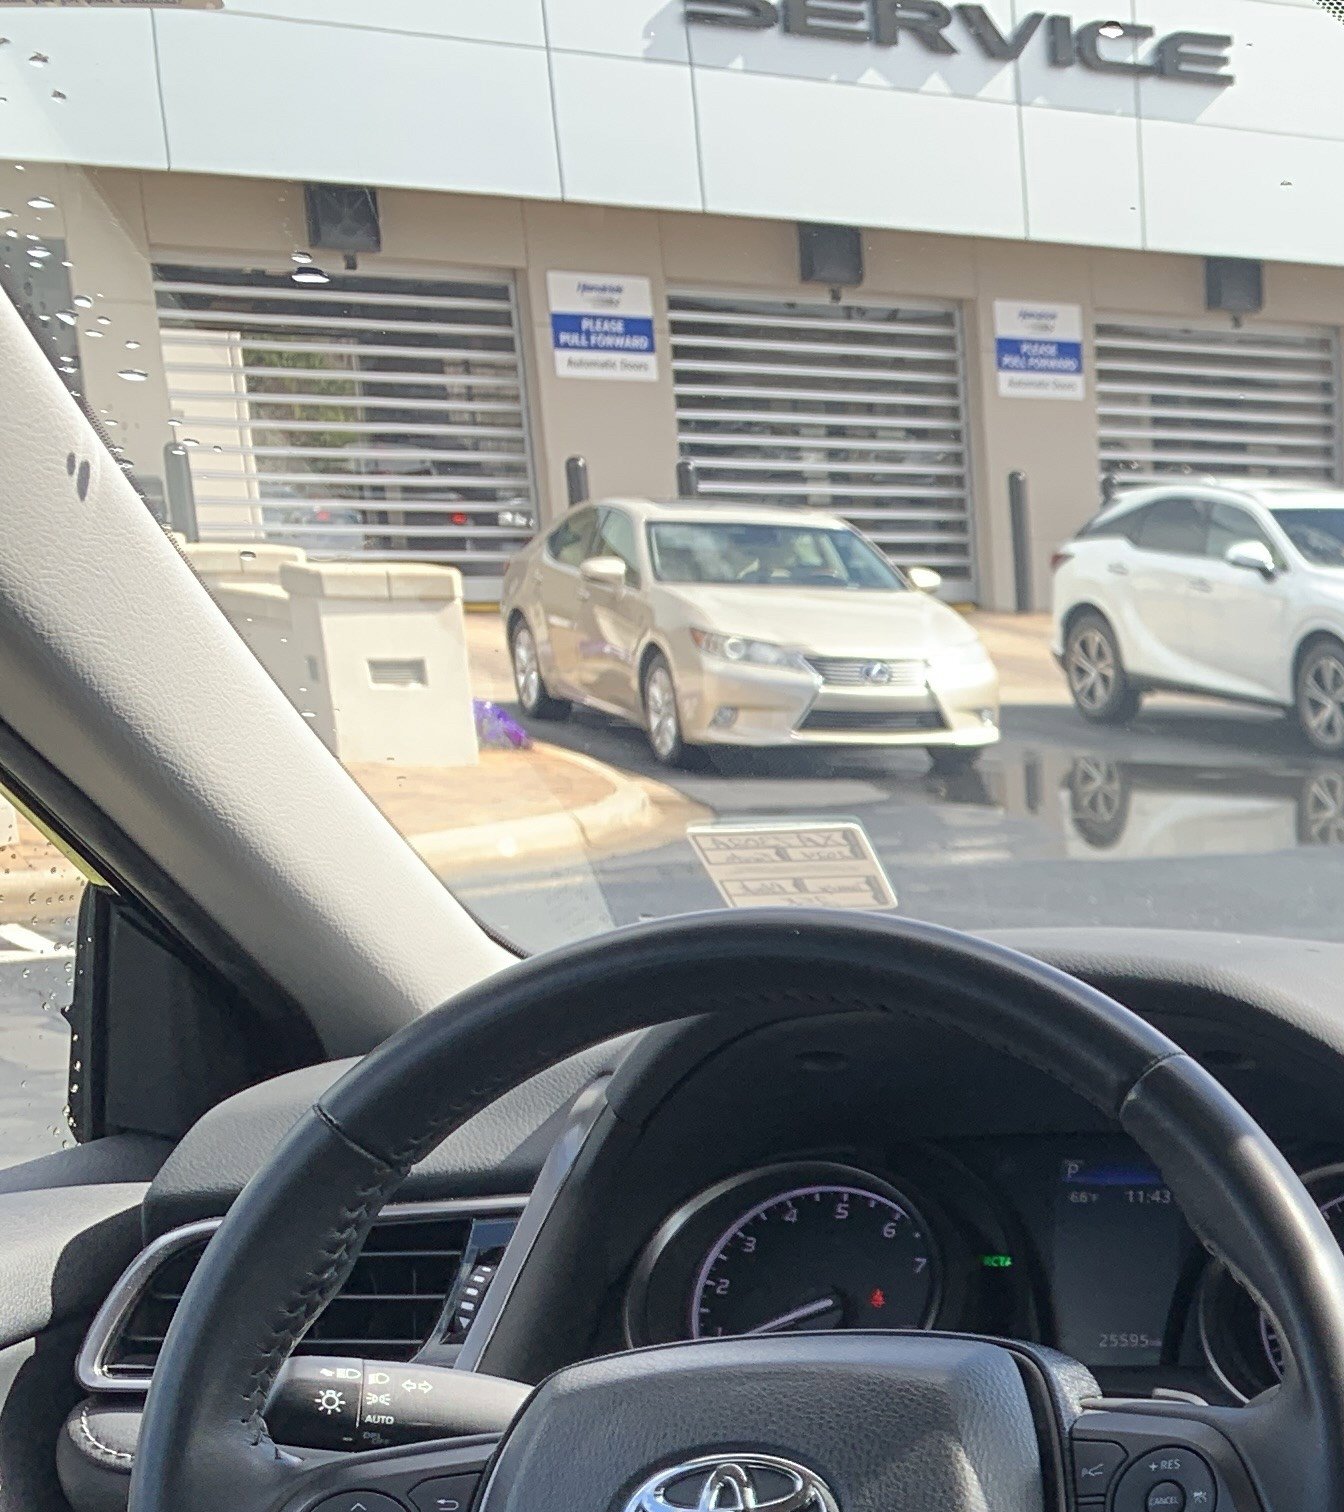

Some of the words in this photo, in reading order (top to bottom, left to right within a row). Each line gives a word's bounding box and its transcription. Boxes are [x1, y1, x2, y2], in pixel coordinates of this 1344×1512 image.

[835, 1204, 849, 1220] 5
[882, 1222, 897, 1239] 6
[743, 1236, 758, 1252] 3
[911, 1256, 927, 1273] 7
[715, 1278, 730, 1295] 2
[364, 1414, 395, 1425] AUTO
